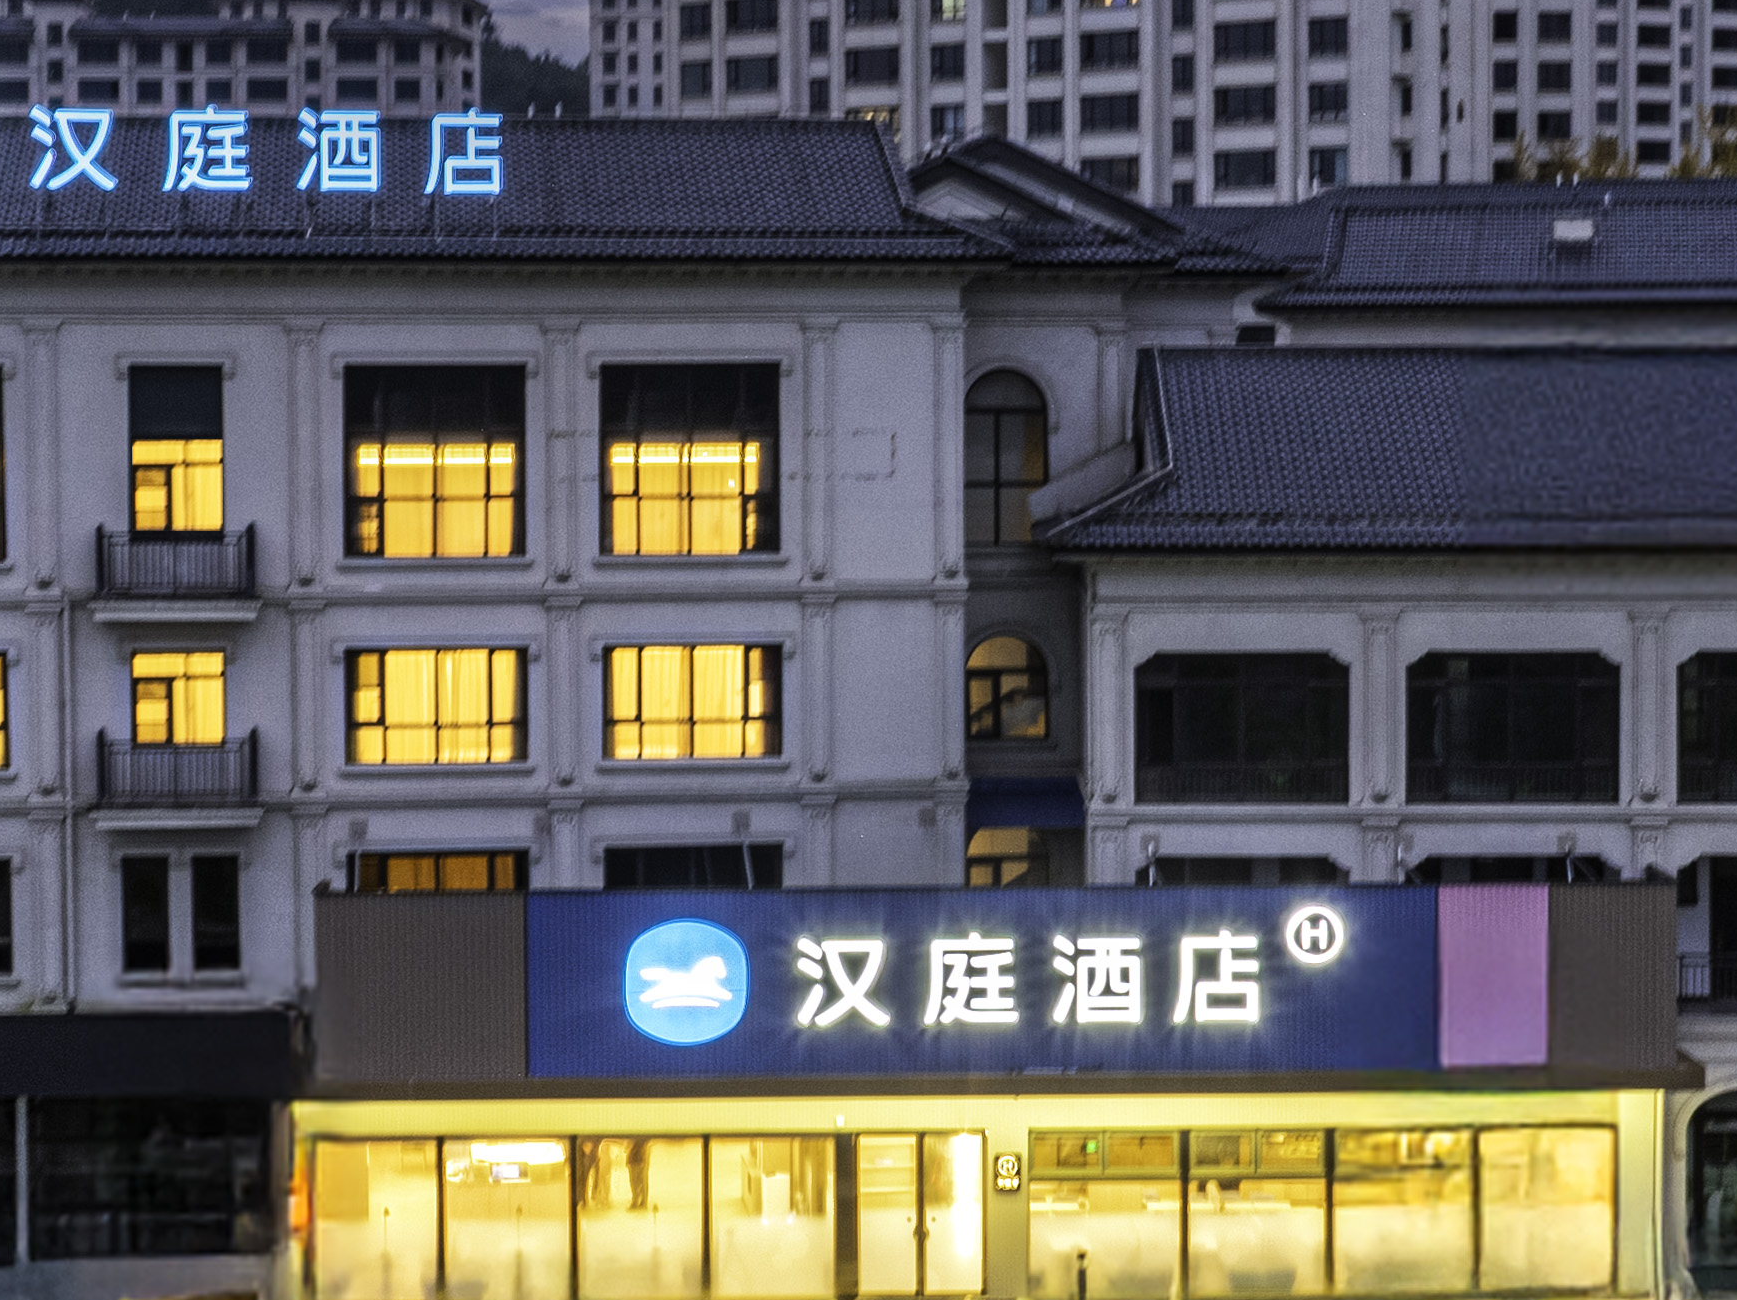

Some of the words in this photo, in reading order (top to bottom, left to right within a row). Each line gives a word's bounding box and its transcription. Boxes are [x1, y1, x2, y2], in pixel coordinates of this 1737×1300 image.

[27, 103, 504, 196] 汉庭酒店
[796, 930, 1261, 1027] 汉庭酒店
